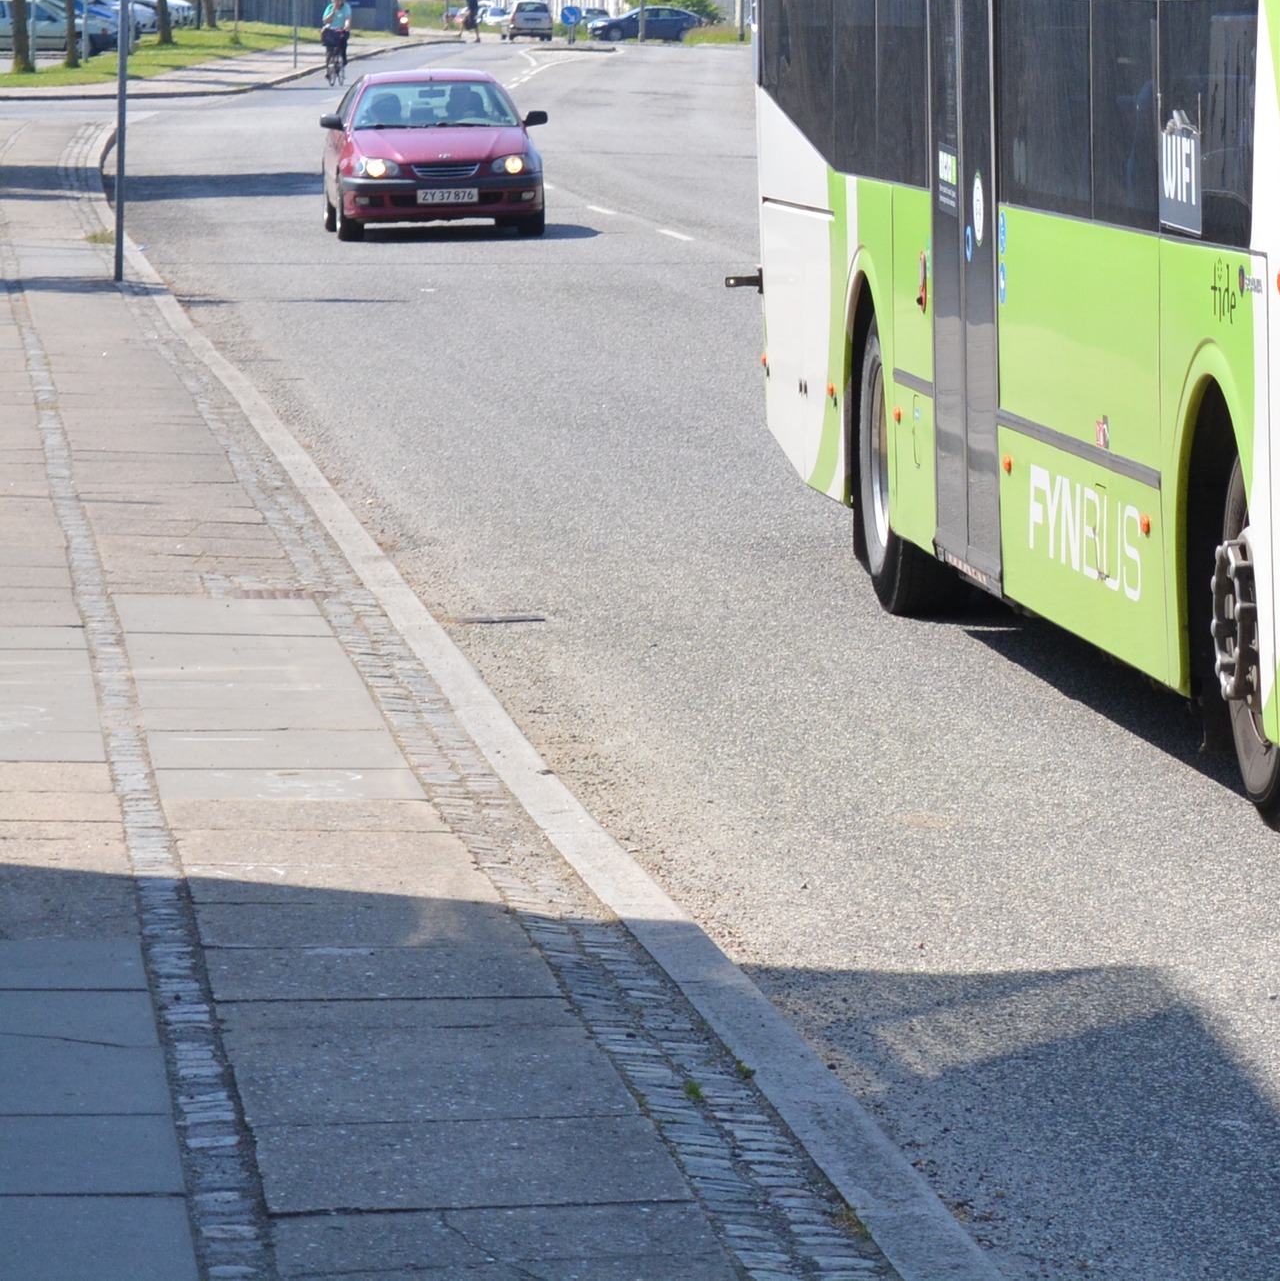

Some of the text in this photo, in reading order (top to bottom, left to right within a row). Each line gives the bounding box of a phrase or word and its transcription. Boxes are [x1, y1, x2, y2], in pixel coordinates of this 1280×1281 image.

[422, 190, 474, 201] ZY 37 876
[1162, 132, 1196, 206] WIFI
[1211, 257, 1237, 325] tide
[1029, 463, 1142, 603] FYNBUS
